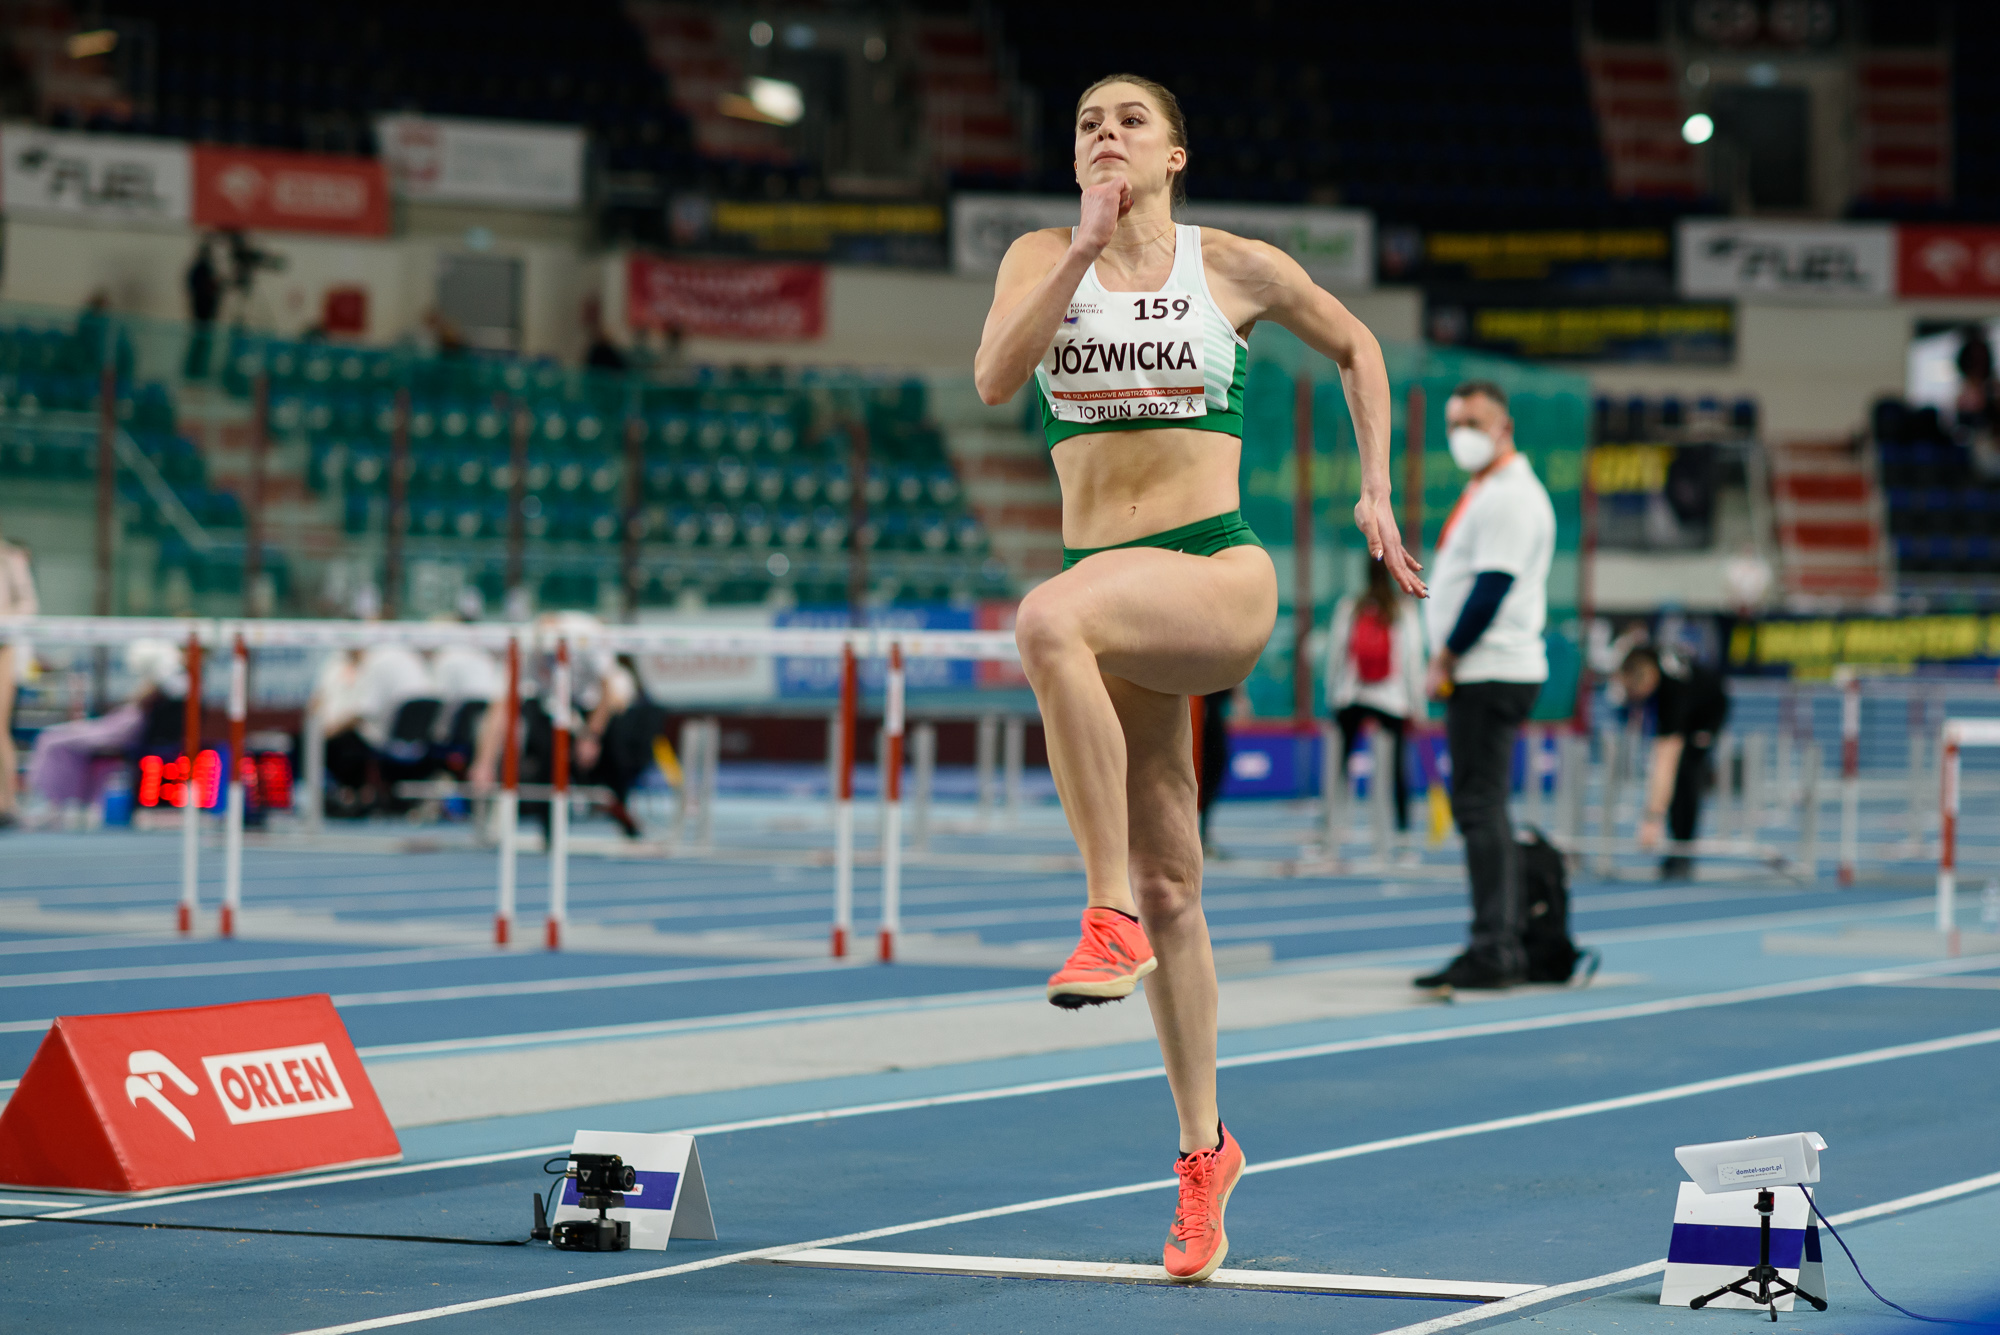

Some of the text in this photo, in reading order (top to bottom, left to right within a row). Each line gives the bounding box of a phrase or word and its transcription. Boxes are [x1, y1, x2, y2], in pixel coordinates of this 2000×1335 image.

[49, 156, 163, 209] FUEL
[1739, 245, 1871, 285] FUEL
[1133, 298, 1190, 321] 159
[1051, 337, 1197, 376] JÓŹWICKA
[1073, 392, 1089, 400] PZLA
[1089, 391, 1117, 399] HALOWE
[1118, 388, 1166, 398] MISTRZOSTWA
[1077, 400, 1180, 420] TORUŃ 2022
[219, 1055, 340, 1112] ORLEN
[1736, 1164, 1783, 1176] domtel-sport.pl
